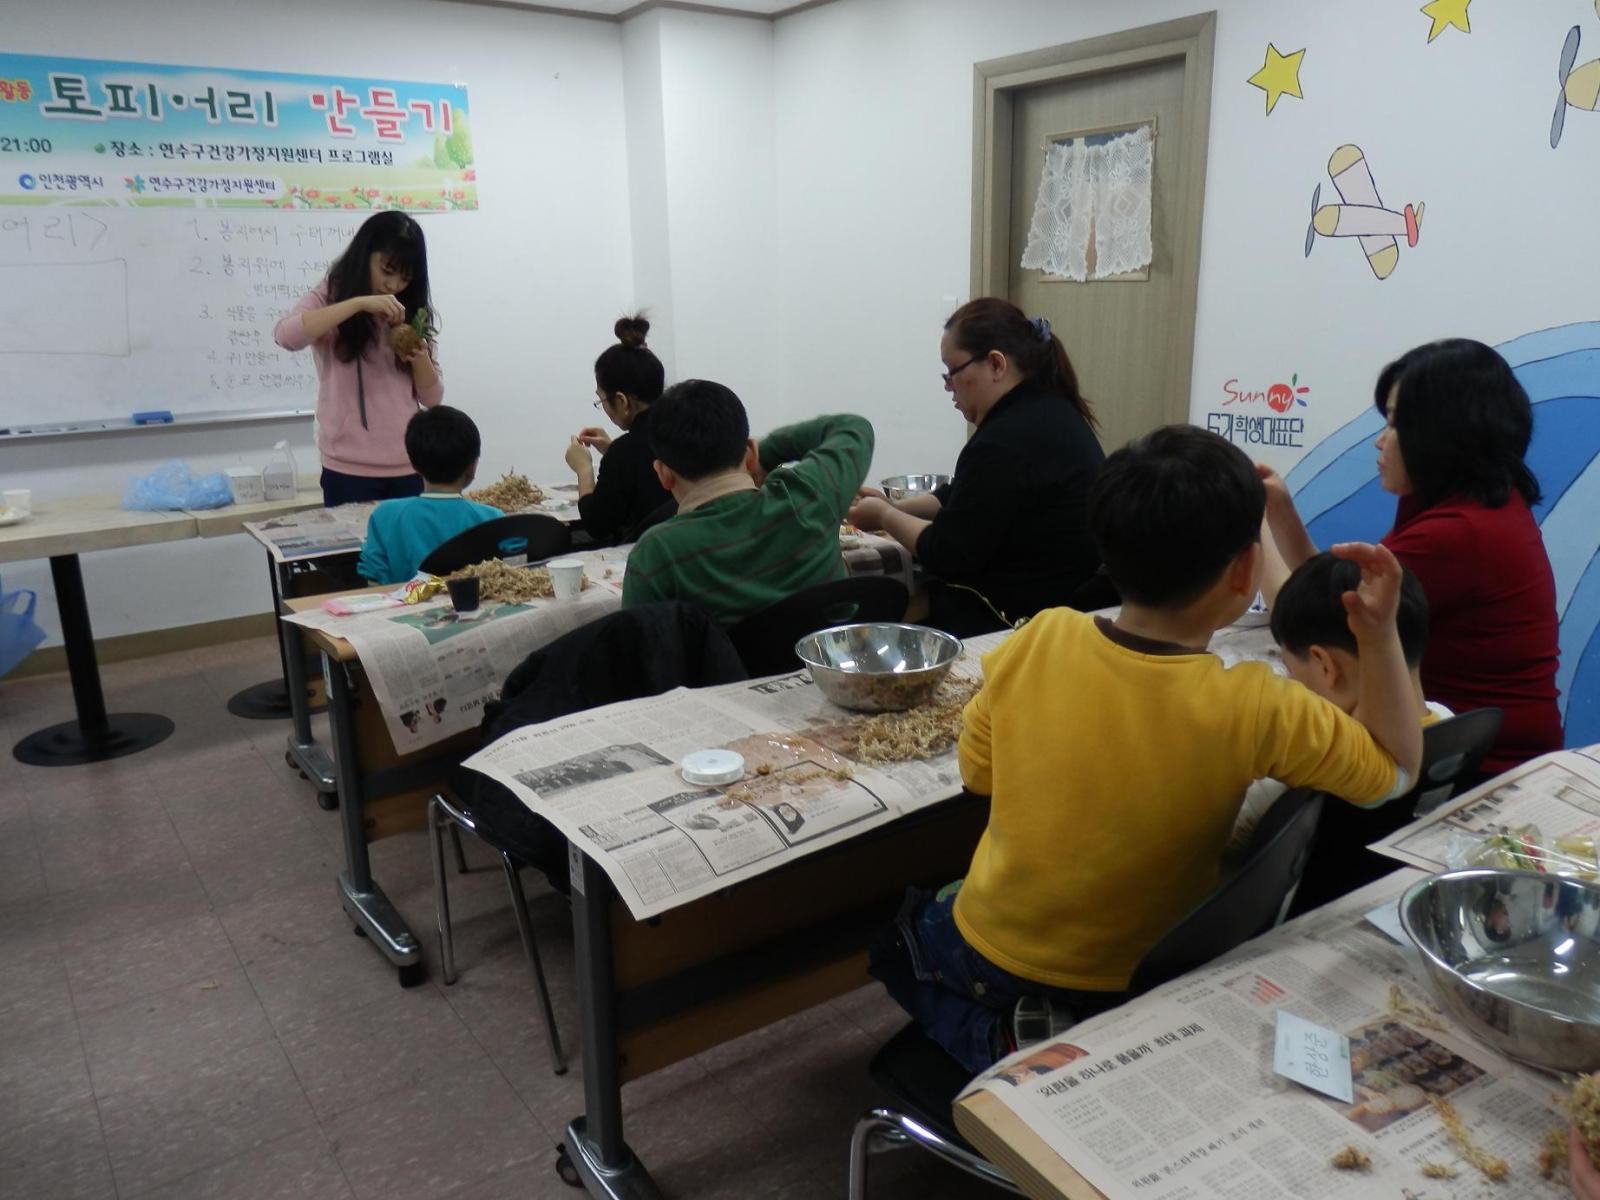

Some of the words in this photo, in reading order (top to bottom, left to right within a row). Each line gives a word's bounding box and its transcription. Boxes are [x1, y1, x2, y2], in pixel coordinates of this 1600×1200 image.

[44, 75, 275, 123] 토피어리
[312, 88, 451, 140] 만들기
[158, 142, 323, 165] 연수구건강가정지원센터
[327, 150, 394, 167] 프로그램실
[38, 172, 105, 191] 인천광역시
[149, 174, 277, 195] 연수구건강가정지원센터
[1221, 378, 1295, 413] Sunny
